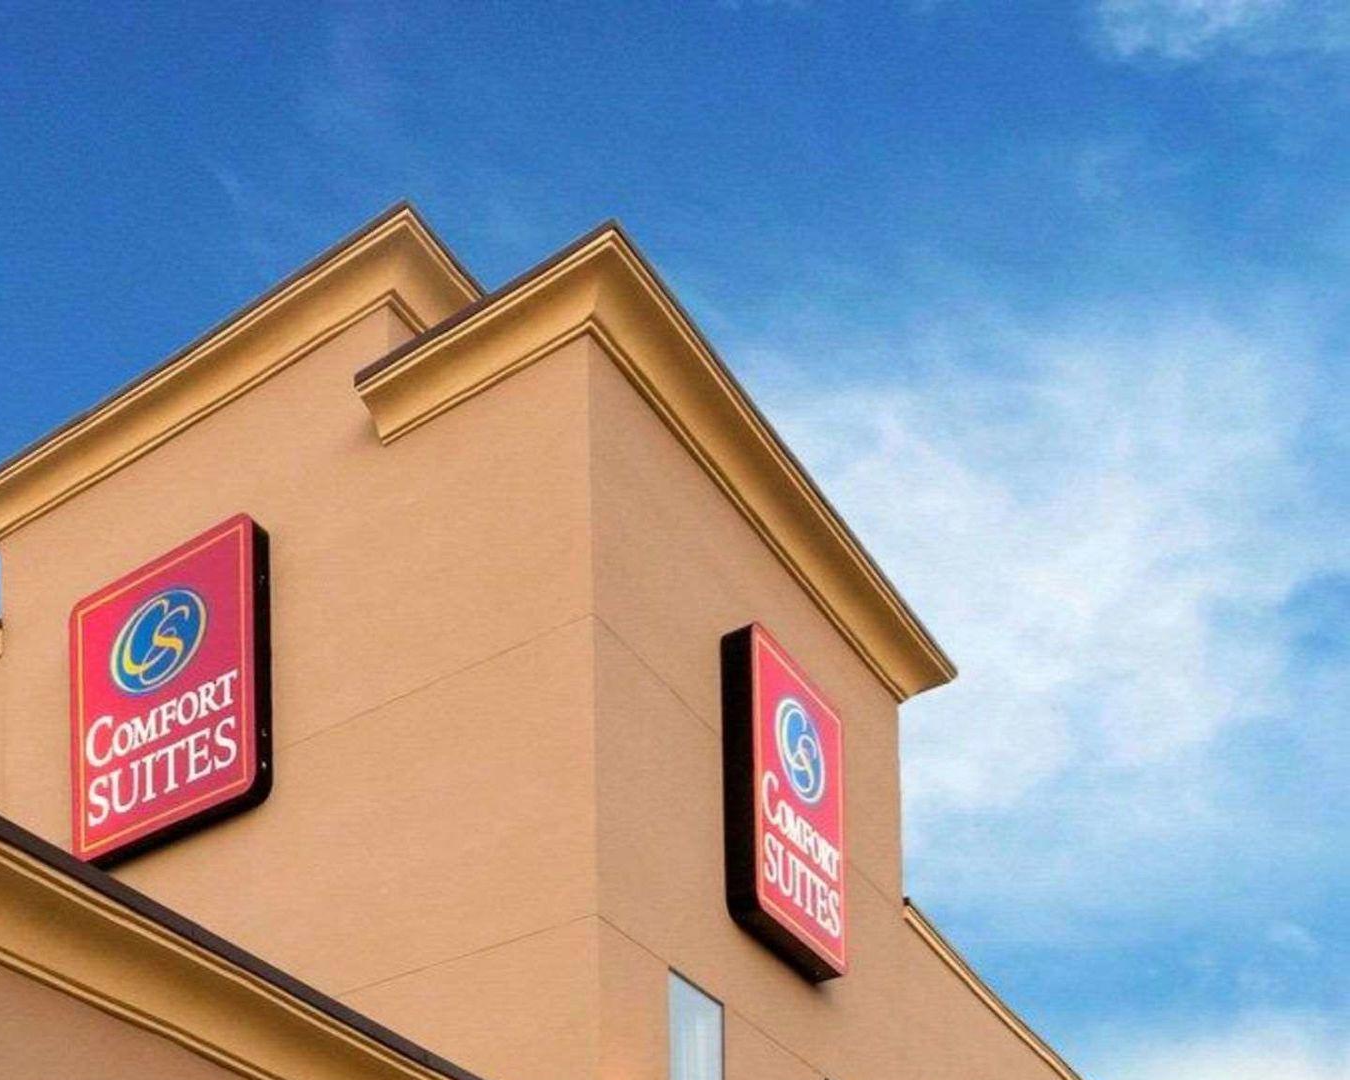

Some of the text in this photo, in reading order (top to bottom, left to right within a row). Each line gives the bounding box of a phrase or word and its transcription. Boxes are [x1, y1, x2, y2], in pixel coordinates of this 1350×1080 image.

[85, 669, 238, 767] COMFORT
[87, 716, 238, 827] SUITES
[761, 771, 840, 881] COMFORT
[763, 831, 841, 938] SUITES
